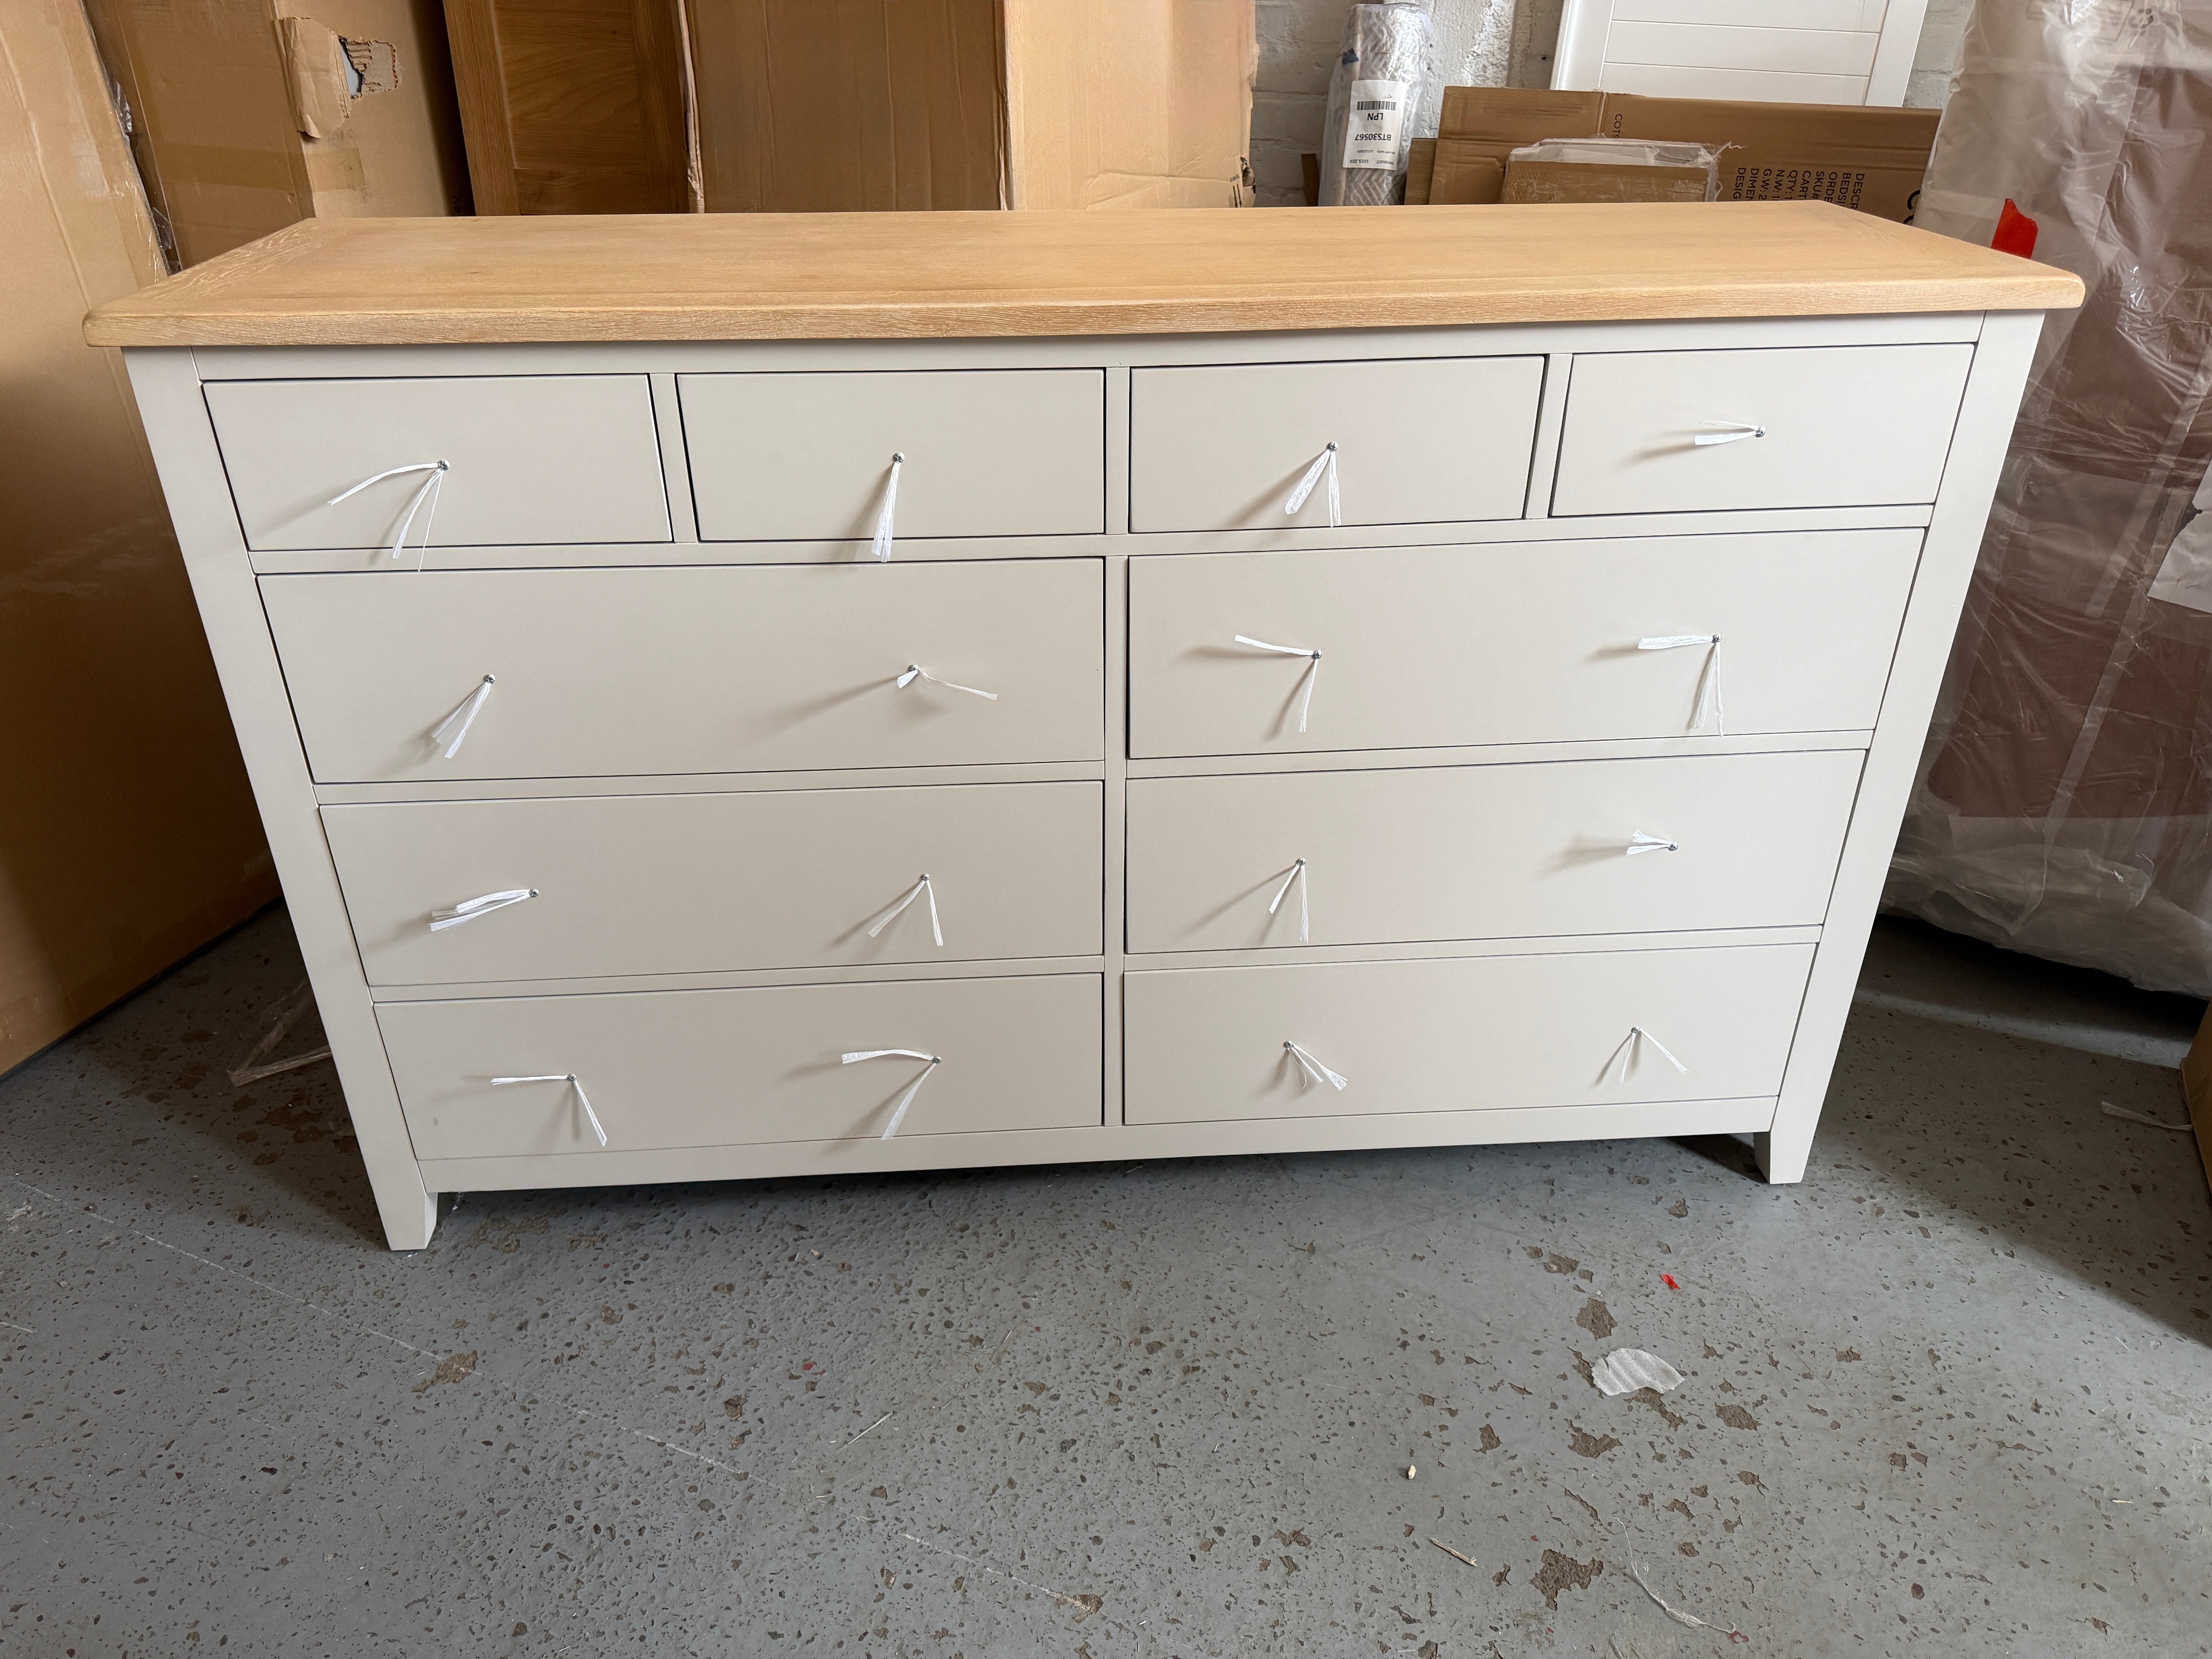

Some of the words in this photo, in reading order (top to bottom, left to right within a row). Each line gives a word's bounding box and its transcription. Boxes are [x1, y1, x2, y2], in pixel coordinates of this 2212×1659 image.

[1367, 113, 1384, 121] LPN
[1760, 168, 1772, 192] G.W:
[1773, 169, 1785, 193] N.W:
[1785, 170, 1798, 194] QTY:
[1798, 170, 1811, 200] CART
[1812, 171, 1824, 200] SKU#
[1837, 173, 1851, 207] BEDSI
[1849, 173, 1865, 209] DESCR
